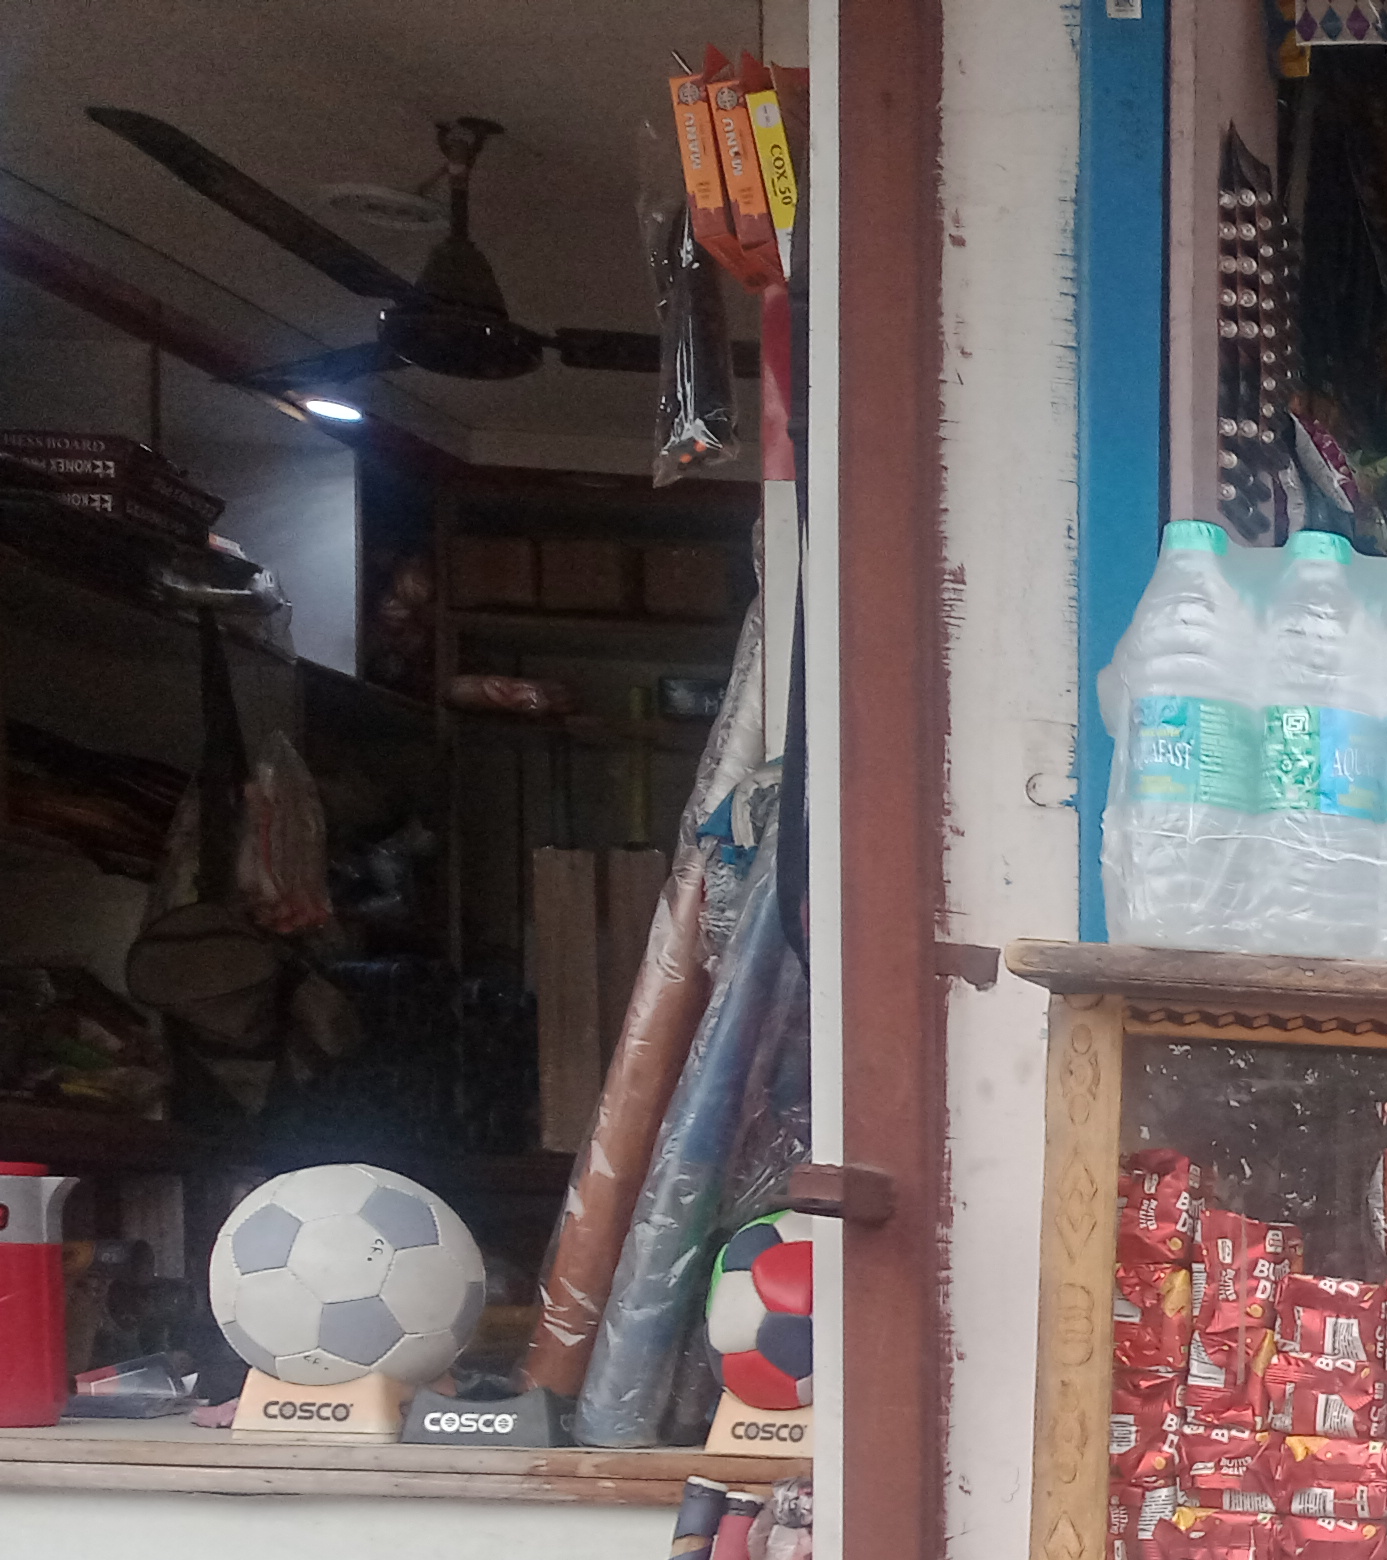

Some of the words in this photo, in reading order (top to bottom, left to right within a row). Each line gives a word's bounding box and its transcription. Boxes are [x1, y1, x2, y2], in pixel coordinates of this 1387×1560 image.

[770, 143, 789, 181] COX
[778, 186, 794, 206] 50
[262, 1400, 353, 1423] COSCO
[423, 1411, 517, 1434] COSCO
[730, 1421, 807, 1444] COSCO
